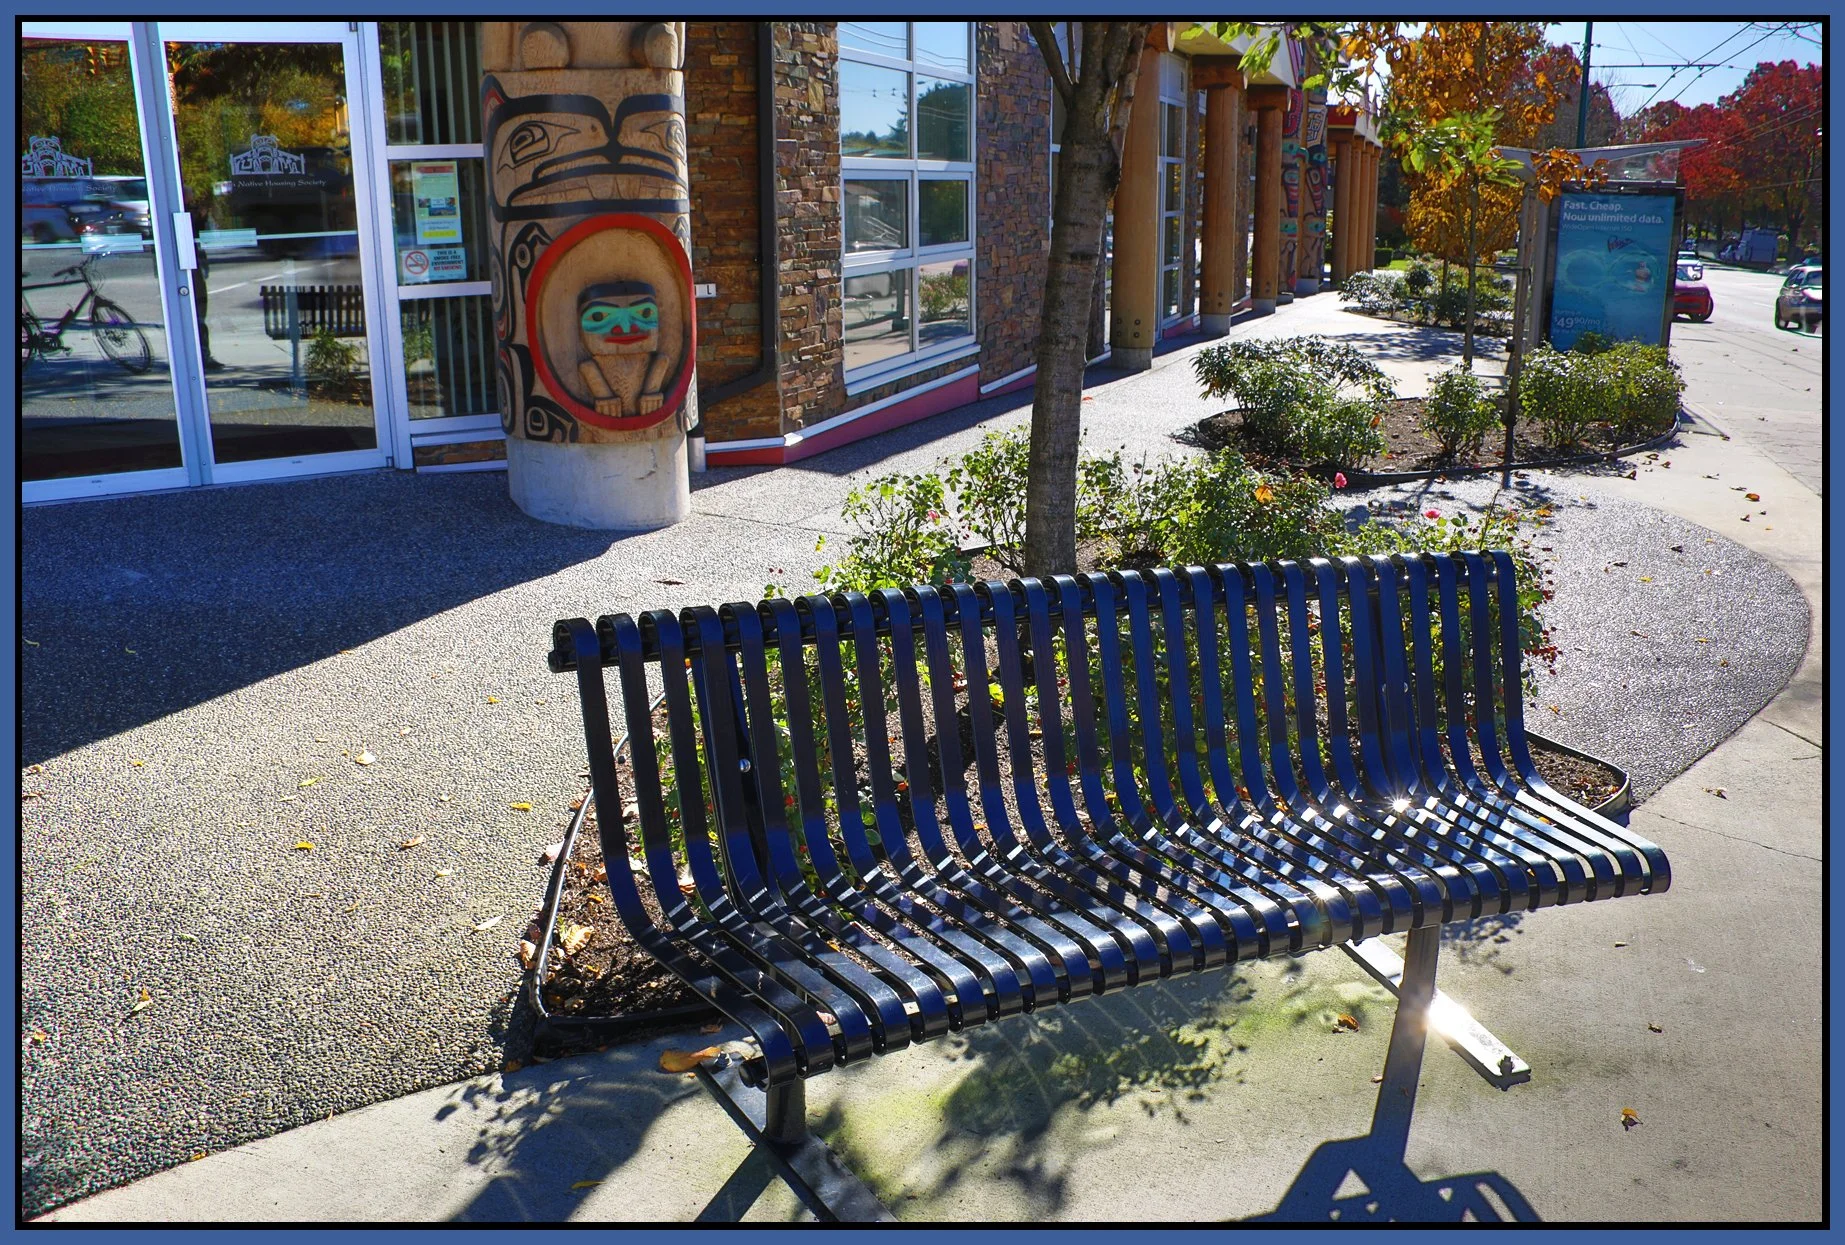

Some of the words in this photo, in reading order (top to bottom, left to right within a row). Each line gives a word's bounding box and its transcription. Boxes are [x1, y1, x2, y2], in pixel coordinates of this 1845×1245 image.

[265, 180, 296, 188] Housing
[297, 179, 326, 187] Society
[1564, 200, 1588, 210] Fast.
[1589, 201, 1624, 212] Cheap.
[1563, 212, 1587, 221] Now
[1588, 213, 1637, 223] unlimited
[1638, 214, 1665, 224] data.
